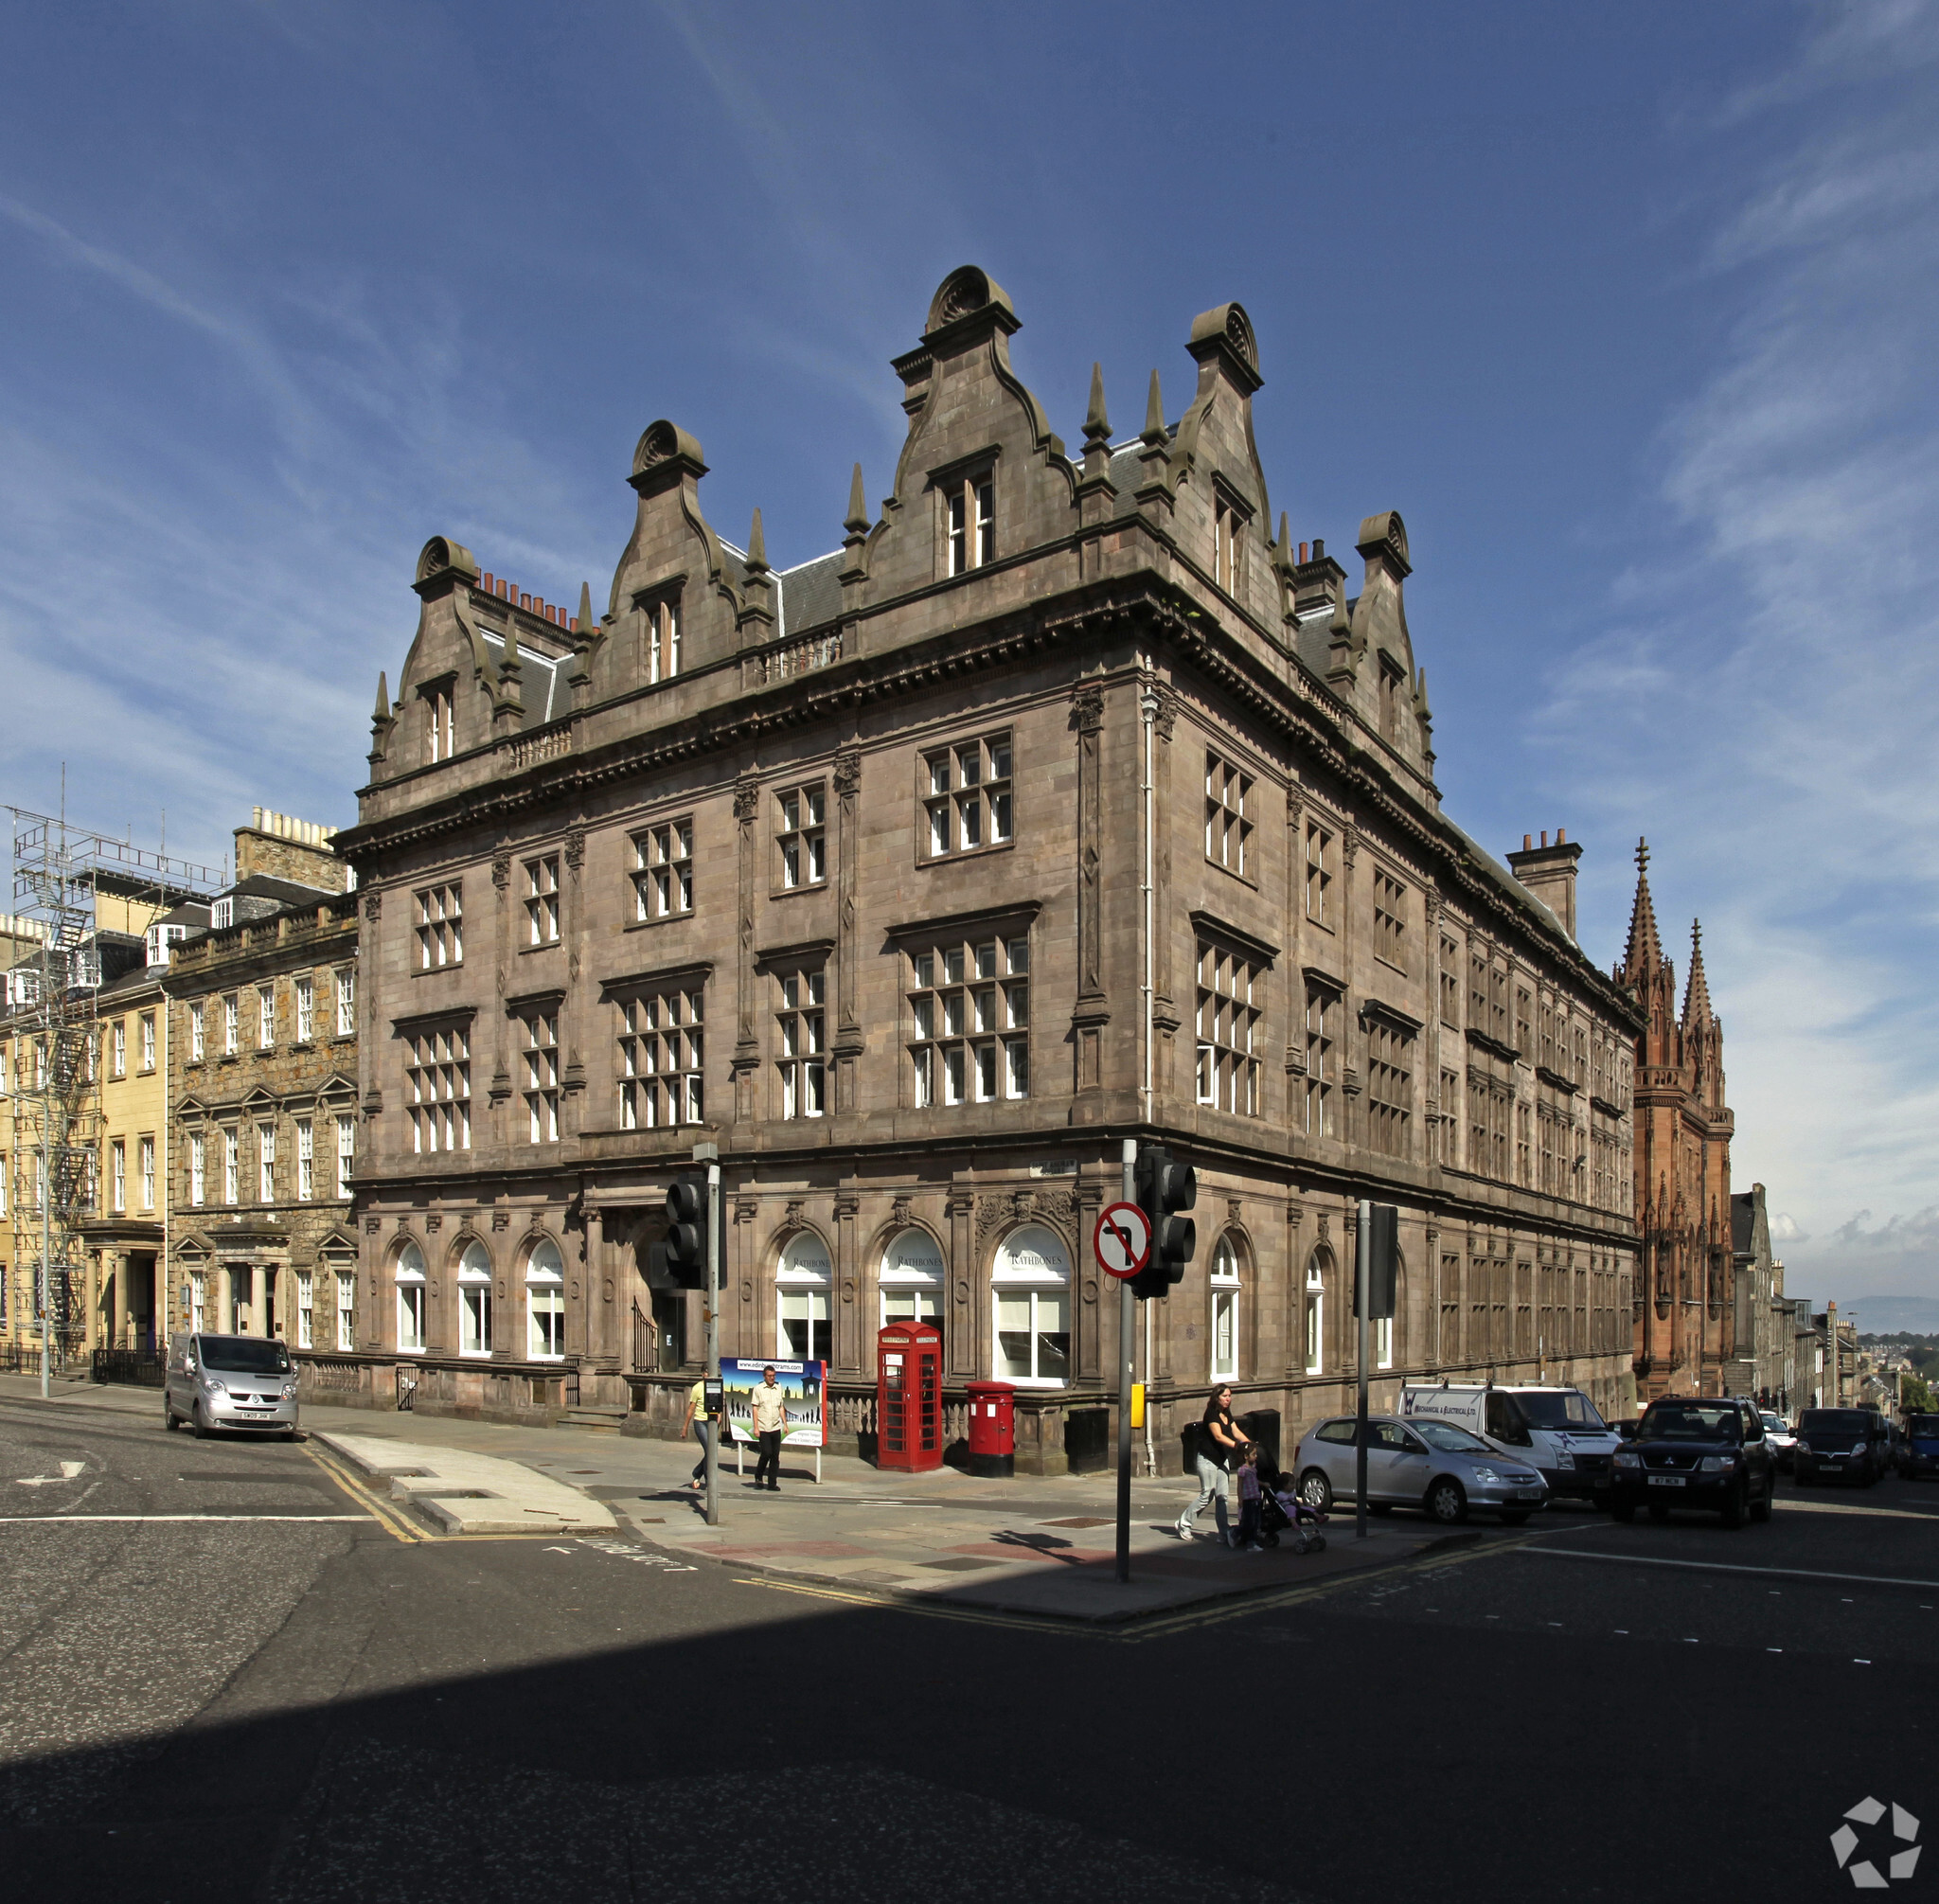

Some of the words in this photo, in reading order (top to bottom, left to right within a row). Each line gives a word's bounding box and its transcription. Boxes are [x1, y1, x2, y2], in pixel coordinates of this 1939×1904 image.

[898, 1255, 943, 1267] RATHBONES
[1011, 1254, 1062, 1265] RATHBONES
[1414, 1404, 1439, 1414] MECHANICAL
[1444, 1406, 1466, 1415] ELECTRICAL
